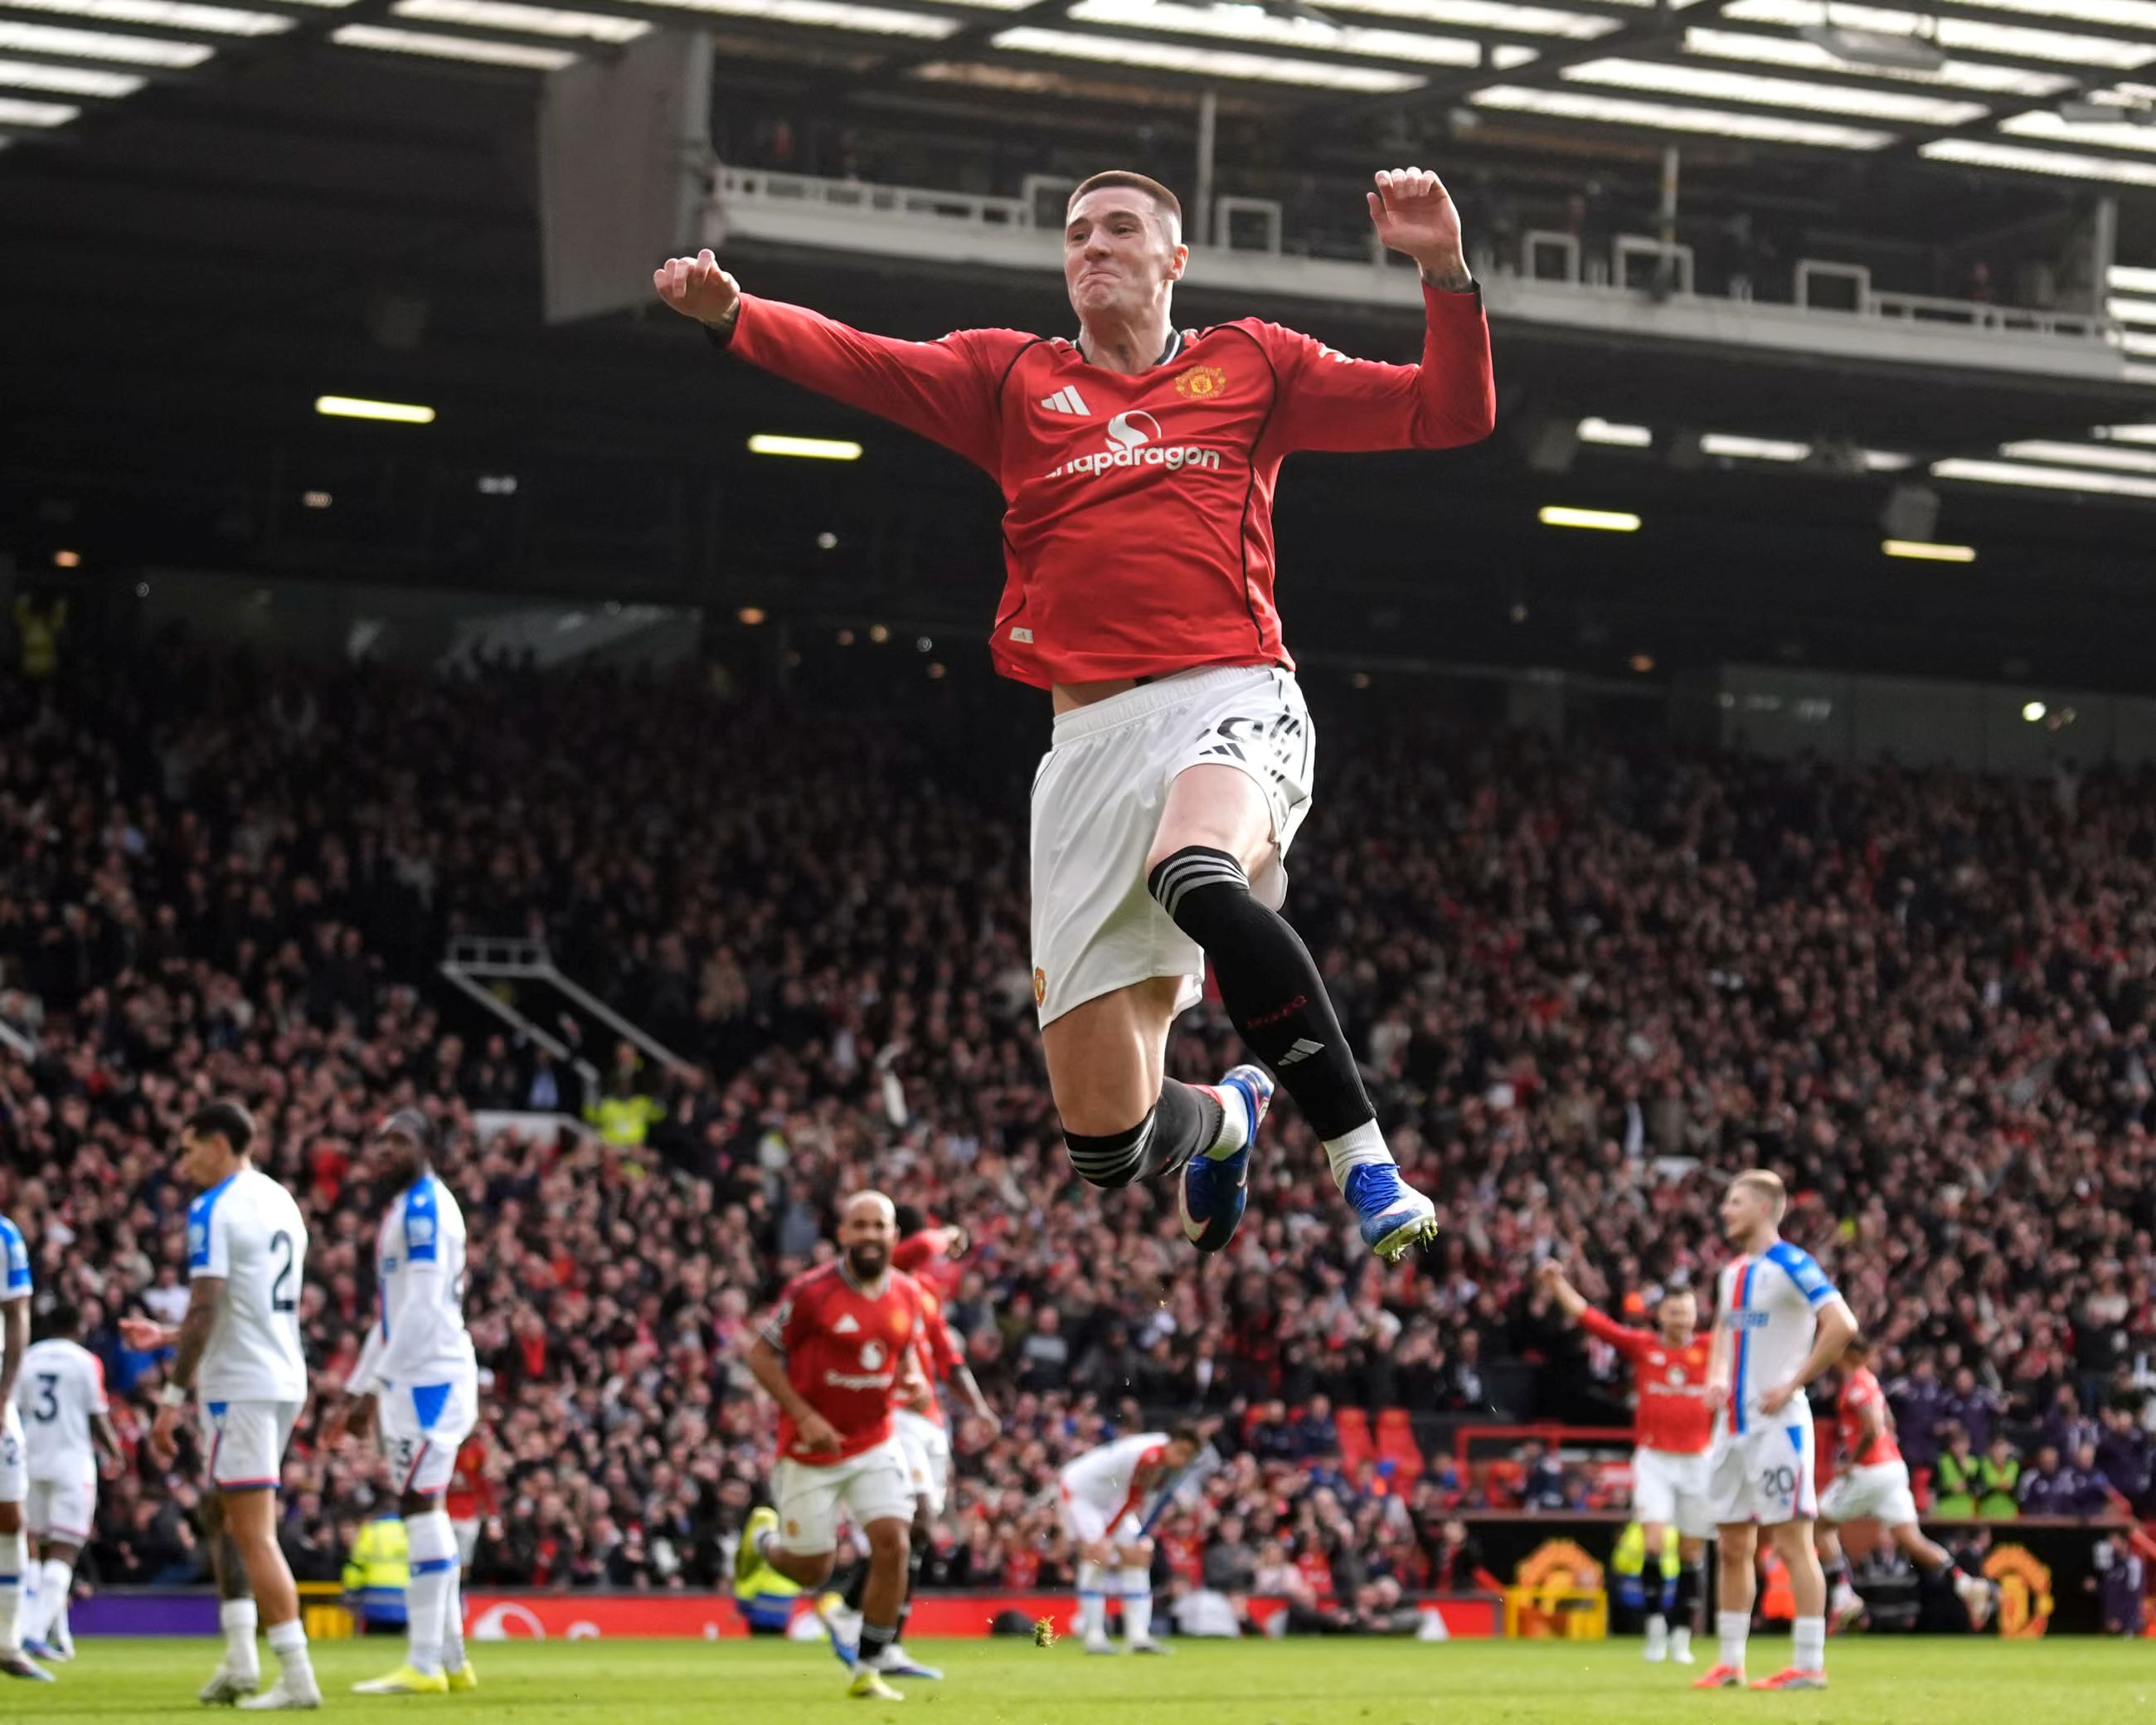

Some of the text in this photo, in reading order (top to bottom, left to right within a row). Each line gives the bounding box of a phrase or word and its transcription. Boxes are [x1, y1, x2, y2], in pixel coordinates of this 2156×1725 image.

[270, 1230, 294, 1312] 2
[35, 1373, 58, 1424] 3
[1762, 1465, 1795, 1499] 20
